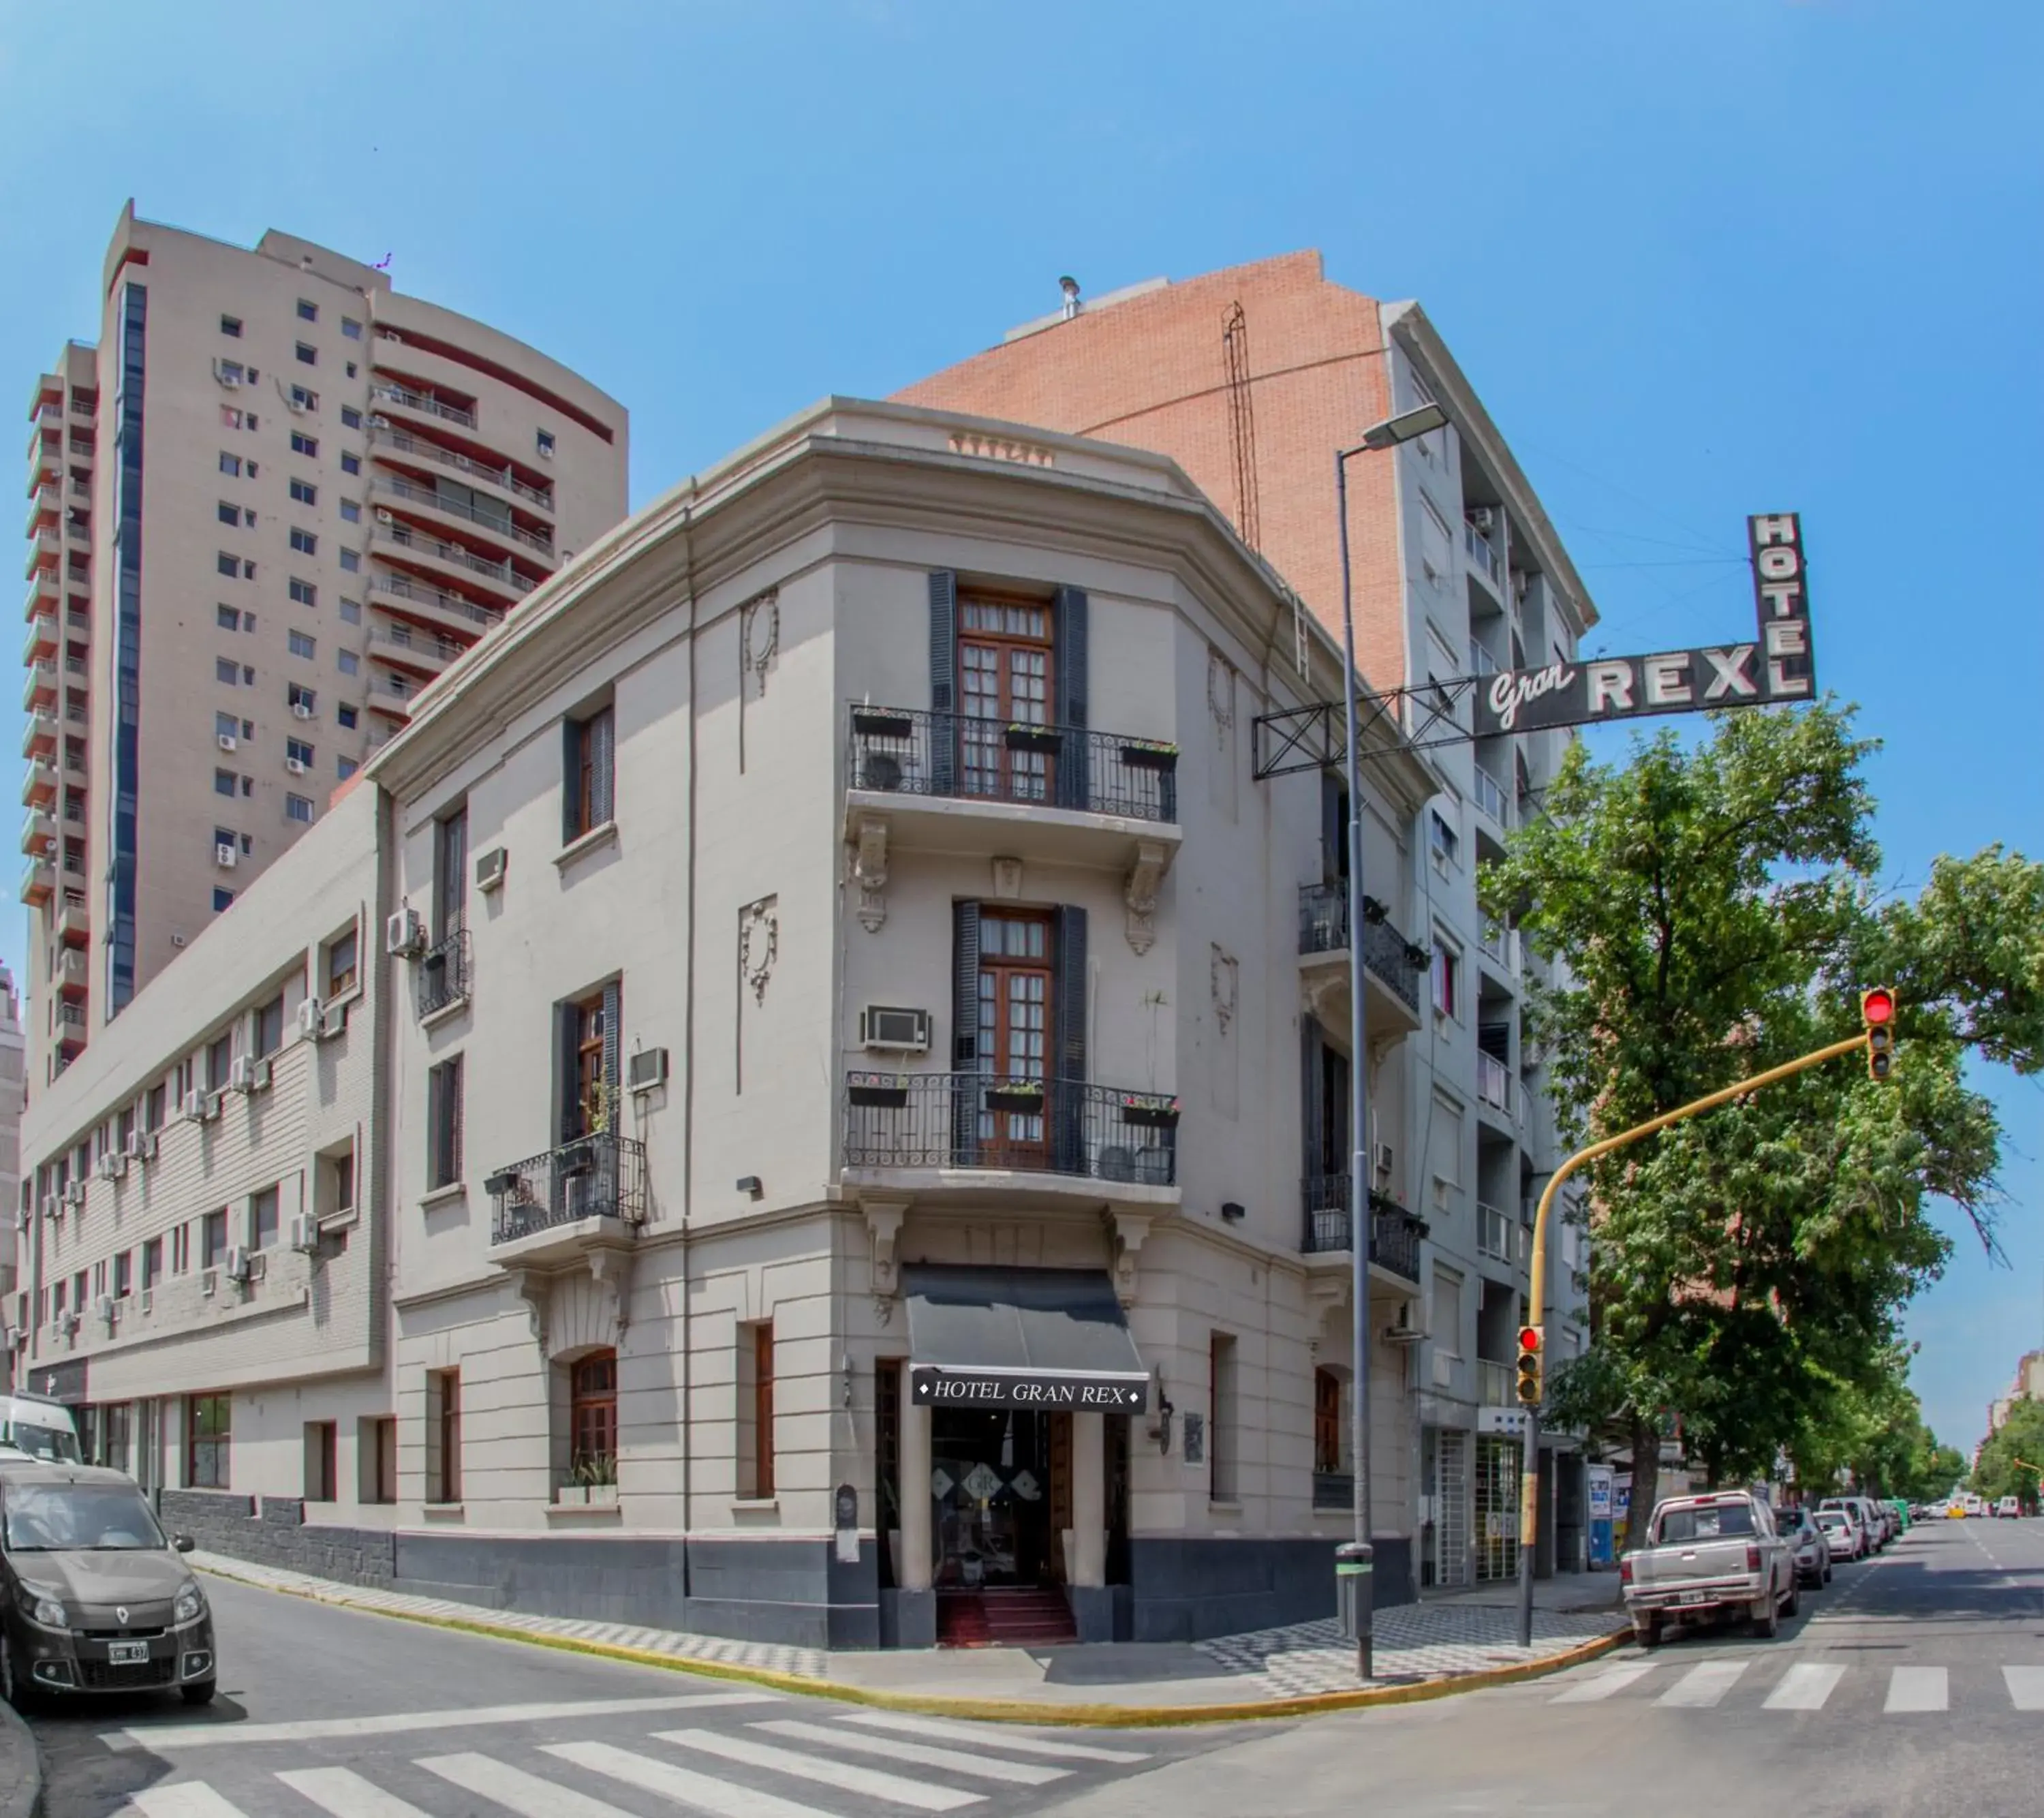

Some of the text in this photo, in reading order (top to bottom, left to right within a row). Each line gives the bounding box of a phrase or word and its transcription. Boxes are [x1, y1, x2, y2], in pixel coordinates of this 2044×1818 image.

[1756, 514, 1808, 695] HOTEL
[1489, 645, 1757, 730] Gran REX
[934, 1381, 1126, 1404] HOTEL GRAN REX
